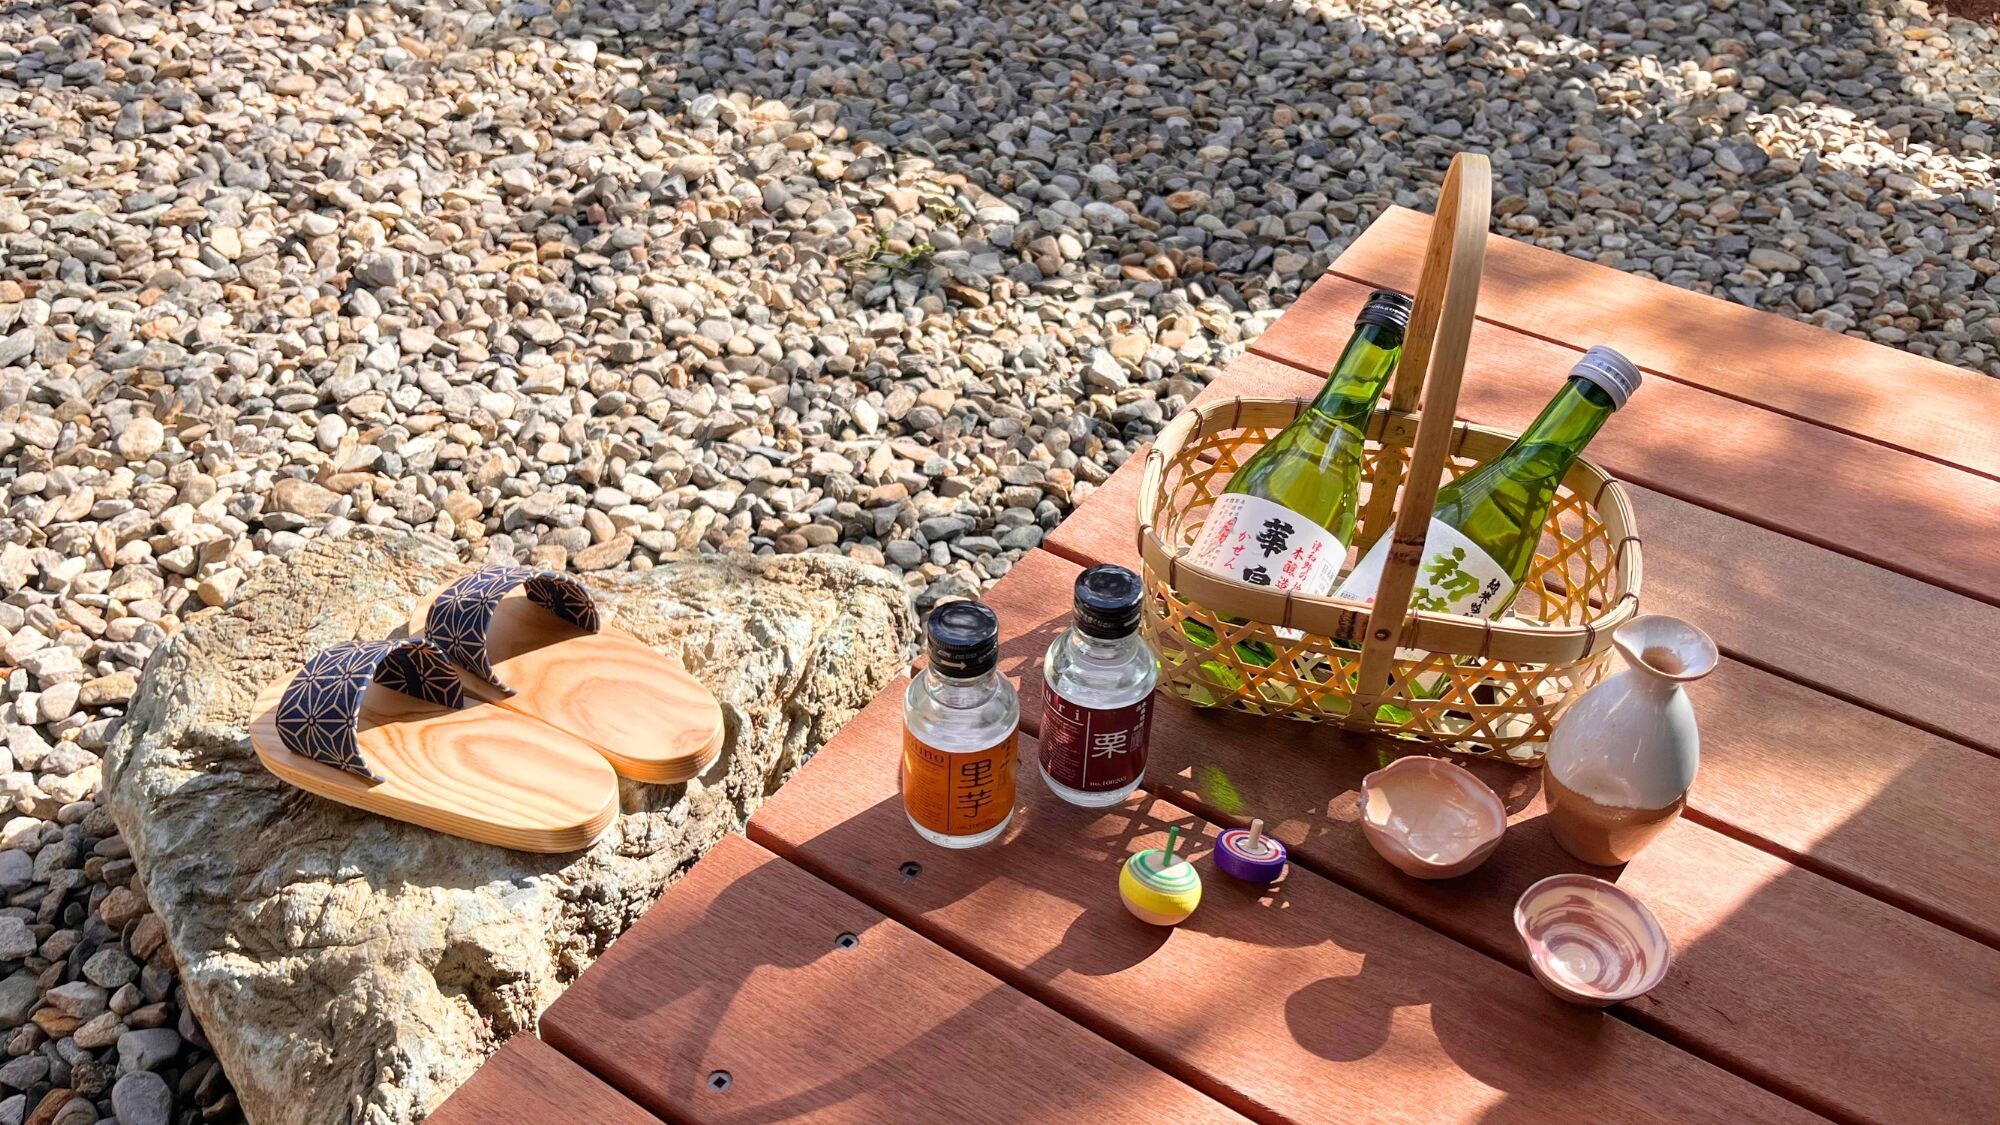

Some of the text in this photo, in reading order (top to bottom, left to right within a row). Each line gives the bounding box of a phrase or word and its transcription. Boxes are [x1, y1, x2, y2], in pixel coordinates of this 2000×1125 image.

[1224, 531, 1251, 570] かせん
[1462, 578, 1501, 618] 純米吟
[1091, 729, 1129, 759] 栗
[957, 758, 994, 818] 里芋
